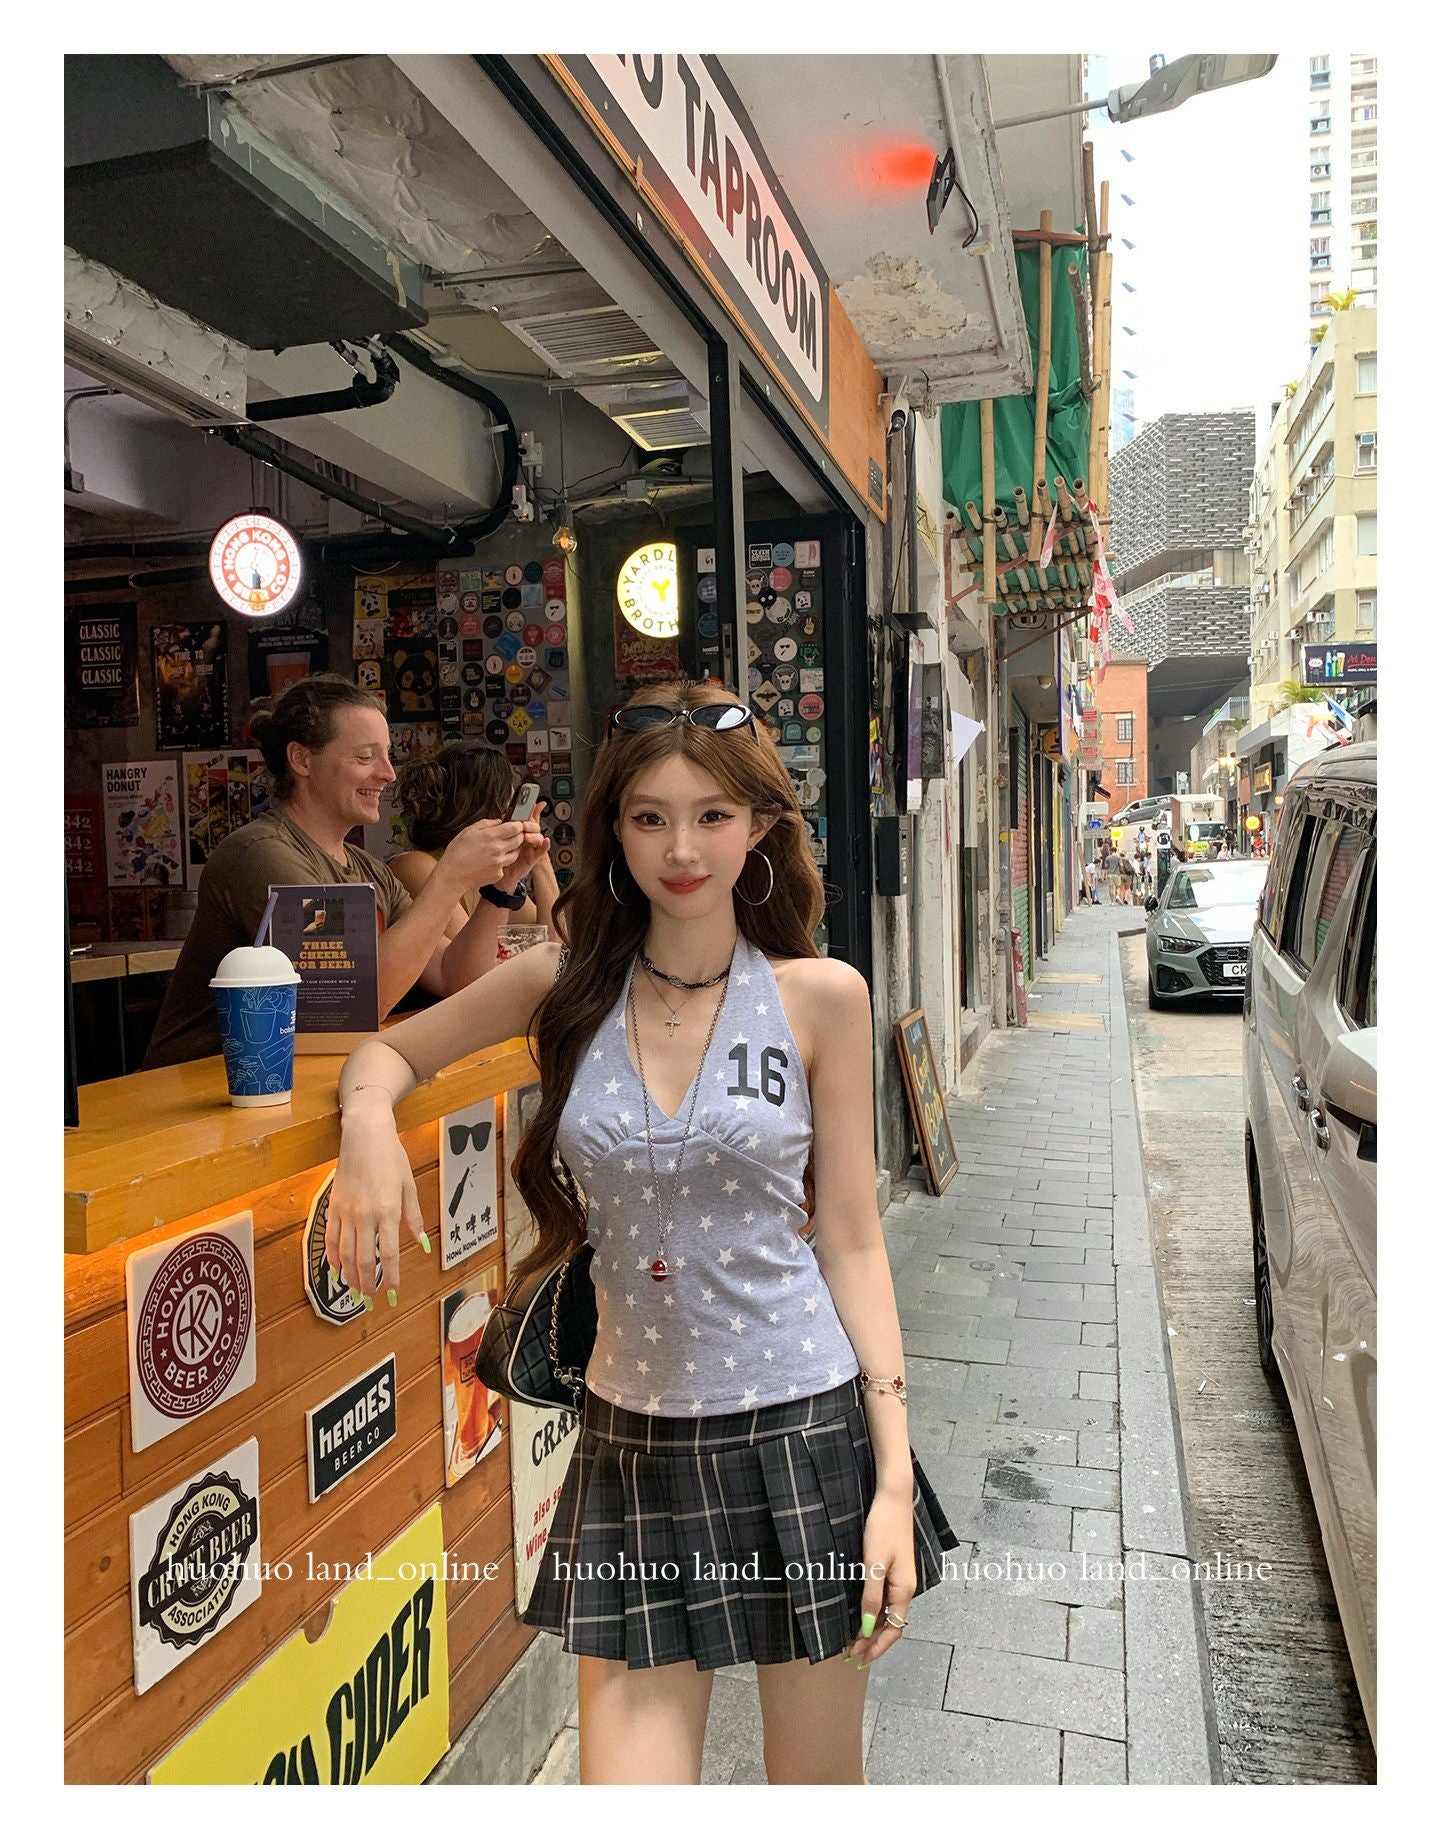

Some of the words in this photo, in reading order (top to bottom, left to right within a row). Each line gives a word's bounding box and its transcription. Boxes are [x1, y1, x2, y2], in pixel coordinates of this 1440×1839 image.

[676, 54, 817, 373] TAPROOM
[223, 531, 250, 571] HONG
[251, 529, 287, 561] KONG
[270, 574, 287, 595] CO
[79, 623, 120, 640] CLASSIC
[81, 645, 122, 662] CLASSIC
[82, 668, 122, 684] CLASSIC
[106, 768, 148, 780] HANGRY
[107, 780, 141, 792] DONUT
[299, 951, 348, 960] CHEERS
[302, 941, 344, 950] THREE
[319, 960, 355, 970] BEER!
[727, 1042, 788, 1107] 16
[446, 1248, 463, 1263] HONG
[462, 1238, 478, 1253] KONG
[476, 1226, 498, 1244] WHISTLE
[156, 1266, 194, 1340] HONG
[199, 1260, 236, 1307] KONG
[163, 1360, 209, 1390] BEER
[211, 1332, 232, 1367] CO
[334, 1440, 363, 1472] BEER
[366, 1426, 380, 1446] CO
[169, 1500, 200, 1548] HONG
[201, 1492, 231, 1512] KONG
[533, 1497, 550, 1527] also
[209, 1511, 252, 1566] BEER
[167, 1563, 236, 1627] ASSOCIATION
[326, 1577, 435, 1785] CIDER
